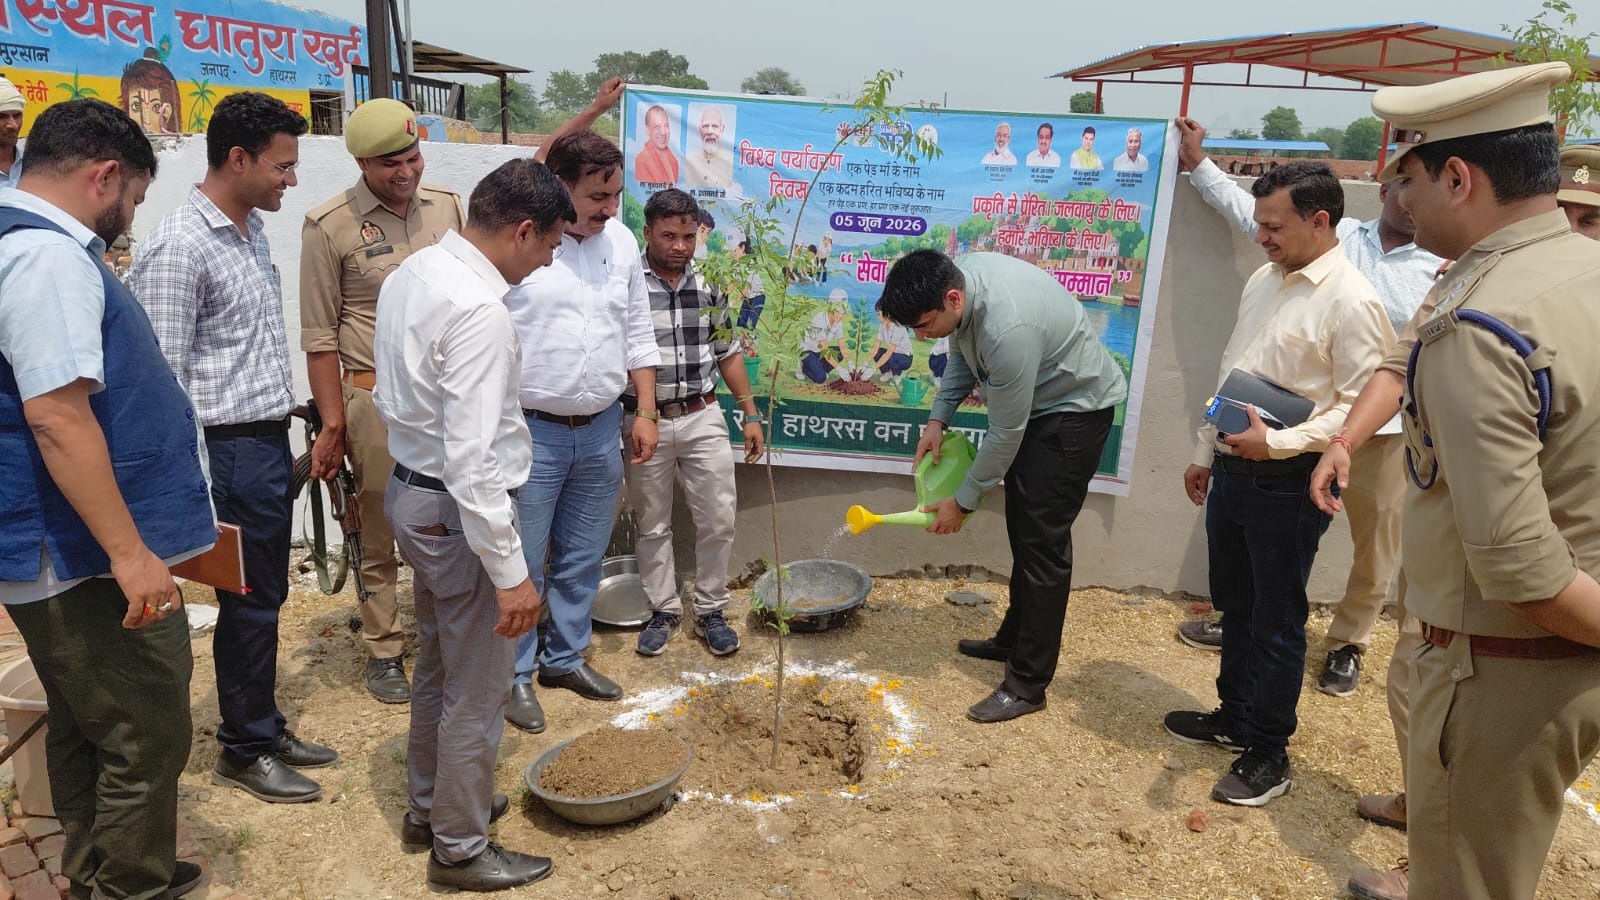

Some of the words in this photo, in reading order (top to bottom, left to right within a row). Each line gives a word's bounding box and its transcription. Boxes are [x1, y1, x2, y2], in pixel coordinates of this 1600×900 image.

[200, 62, 231, 80] जनपद
[269, 69, 297, 84] हाथरस
[26, 80, 48, 104] देवी
[740, 140, 777, 167] विश्व
[780, 144, 843, 172] पर्यावरण
[847, 163, 862, 176] एक
[864, 160, 878, 177] पेड़
[880, 161, 890, 176] माँ
[892, 161, 901, 176] के
[903, 166, 920, 178] नाम
[769, 171, 809, 200] दिवस
[819, 182, 834, 196] एक
[836, 183, 858, 196] कदम
[859, 180, 883, 198] हरित
[885, 182, 914, 199] भविष्य
[916, 183, 925, 199] के
[927, 189, 945, 201] नाम
[973, 191, 1004, 220] प्रकृति
[1008, 193, 1018, 215] से
[1053, 201, 1096, 224] जलवायु
[1098, 198, 1111, 219] के
[835, 215, 853, 227] 05
[858, 215, 882, 232] जून
[886, 218, 922, 231] 2026
[998, 225, 1026, 247] हमारे
[1028, 226, 1063, 248] भविष्य
[1065, 227, 1078, 248] के
[782, 413, 867, 440] हाथरस
[874, 421, 912, 444] वन
